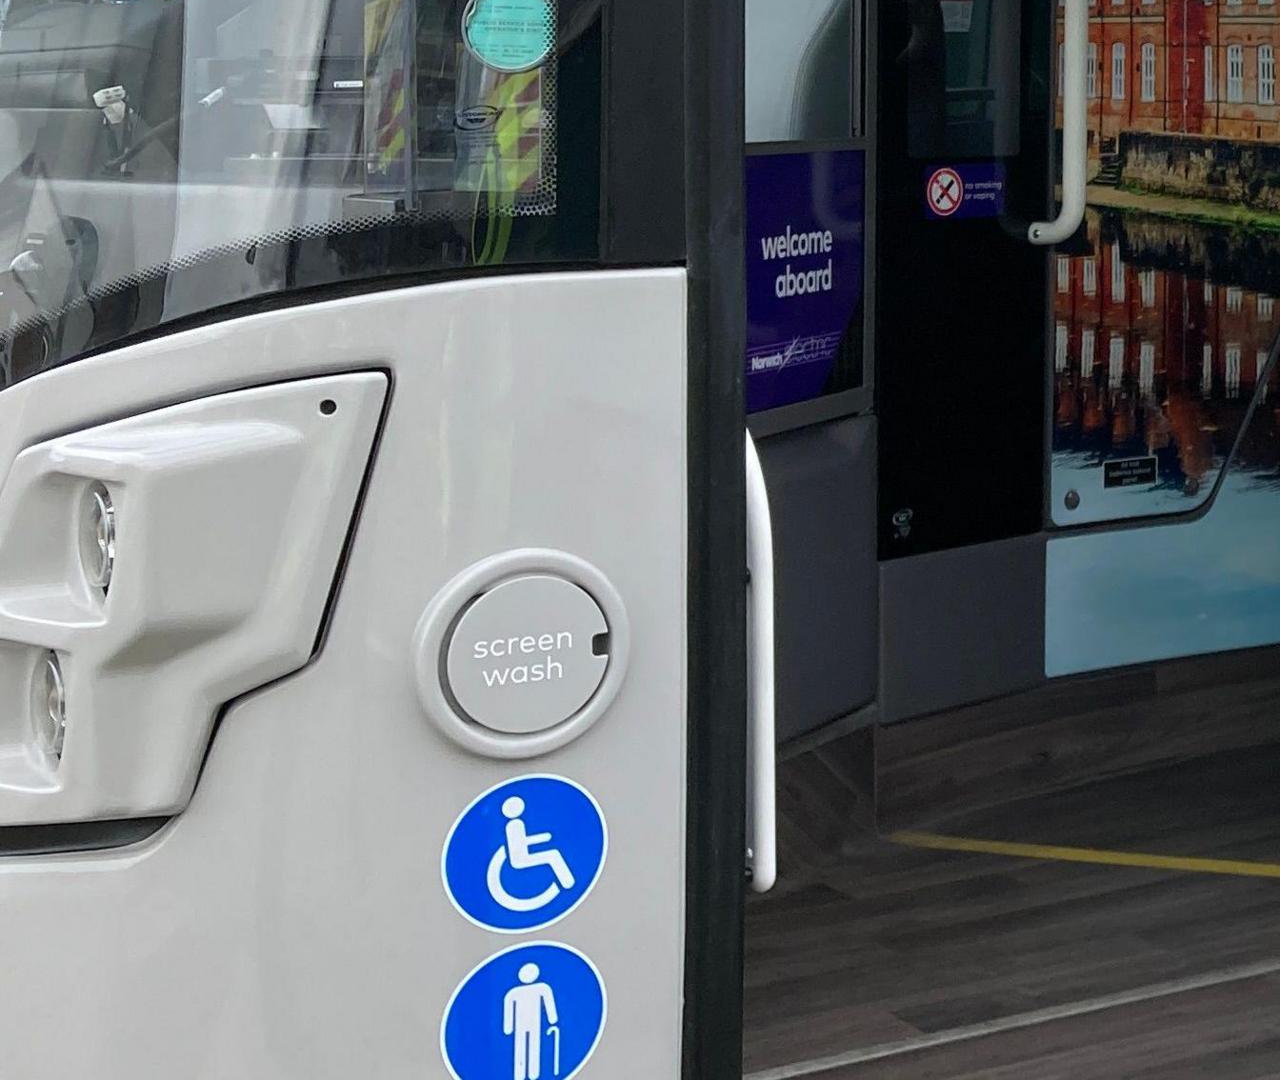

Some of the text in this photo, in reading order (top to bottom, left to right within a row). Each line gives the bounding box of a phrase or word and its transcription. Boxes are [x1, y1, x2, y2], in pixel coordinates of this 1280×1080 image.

[761, 225, 833, 261] welcome
[775, 258, 833, 299] aboard
[752, 351, 784, 372] Norwich
[473, 631, 573, 660] screen
[482, 655, 564, 687] wash
